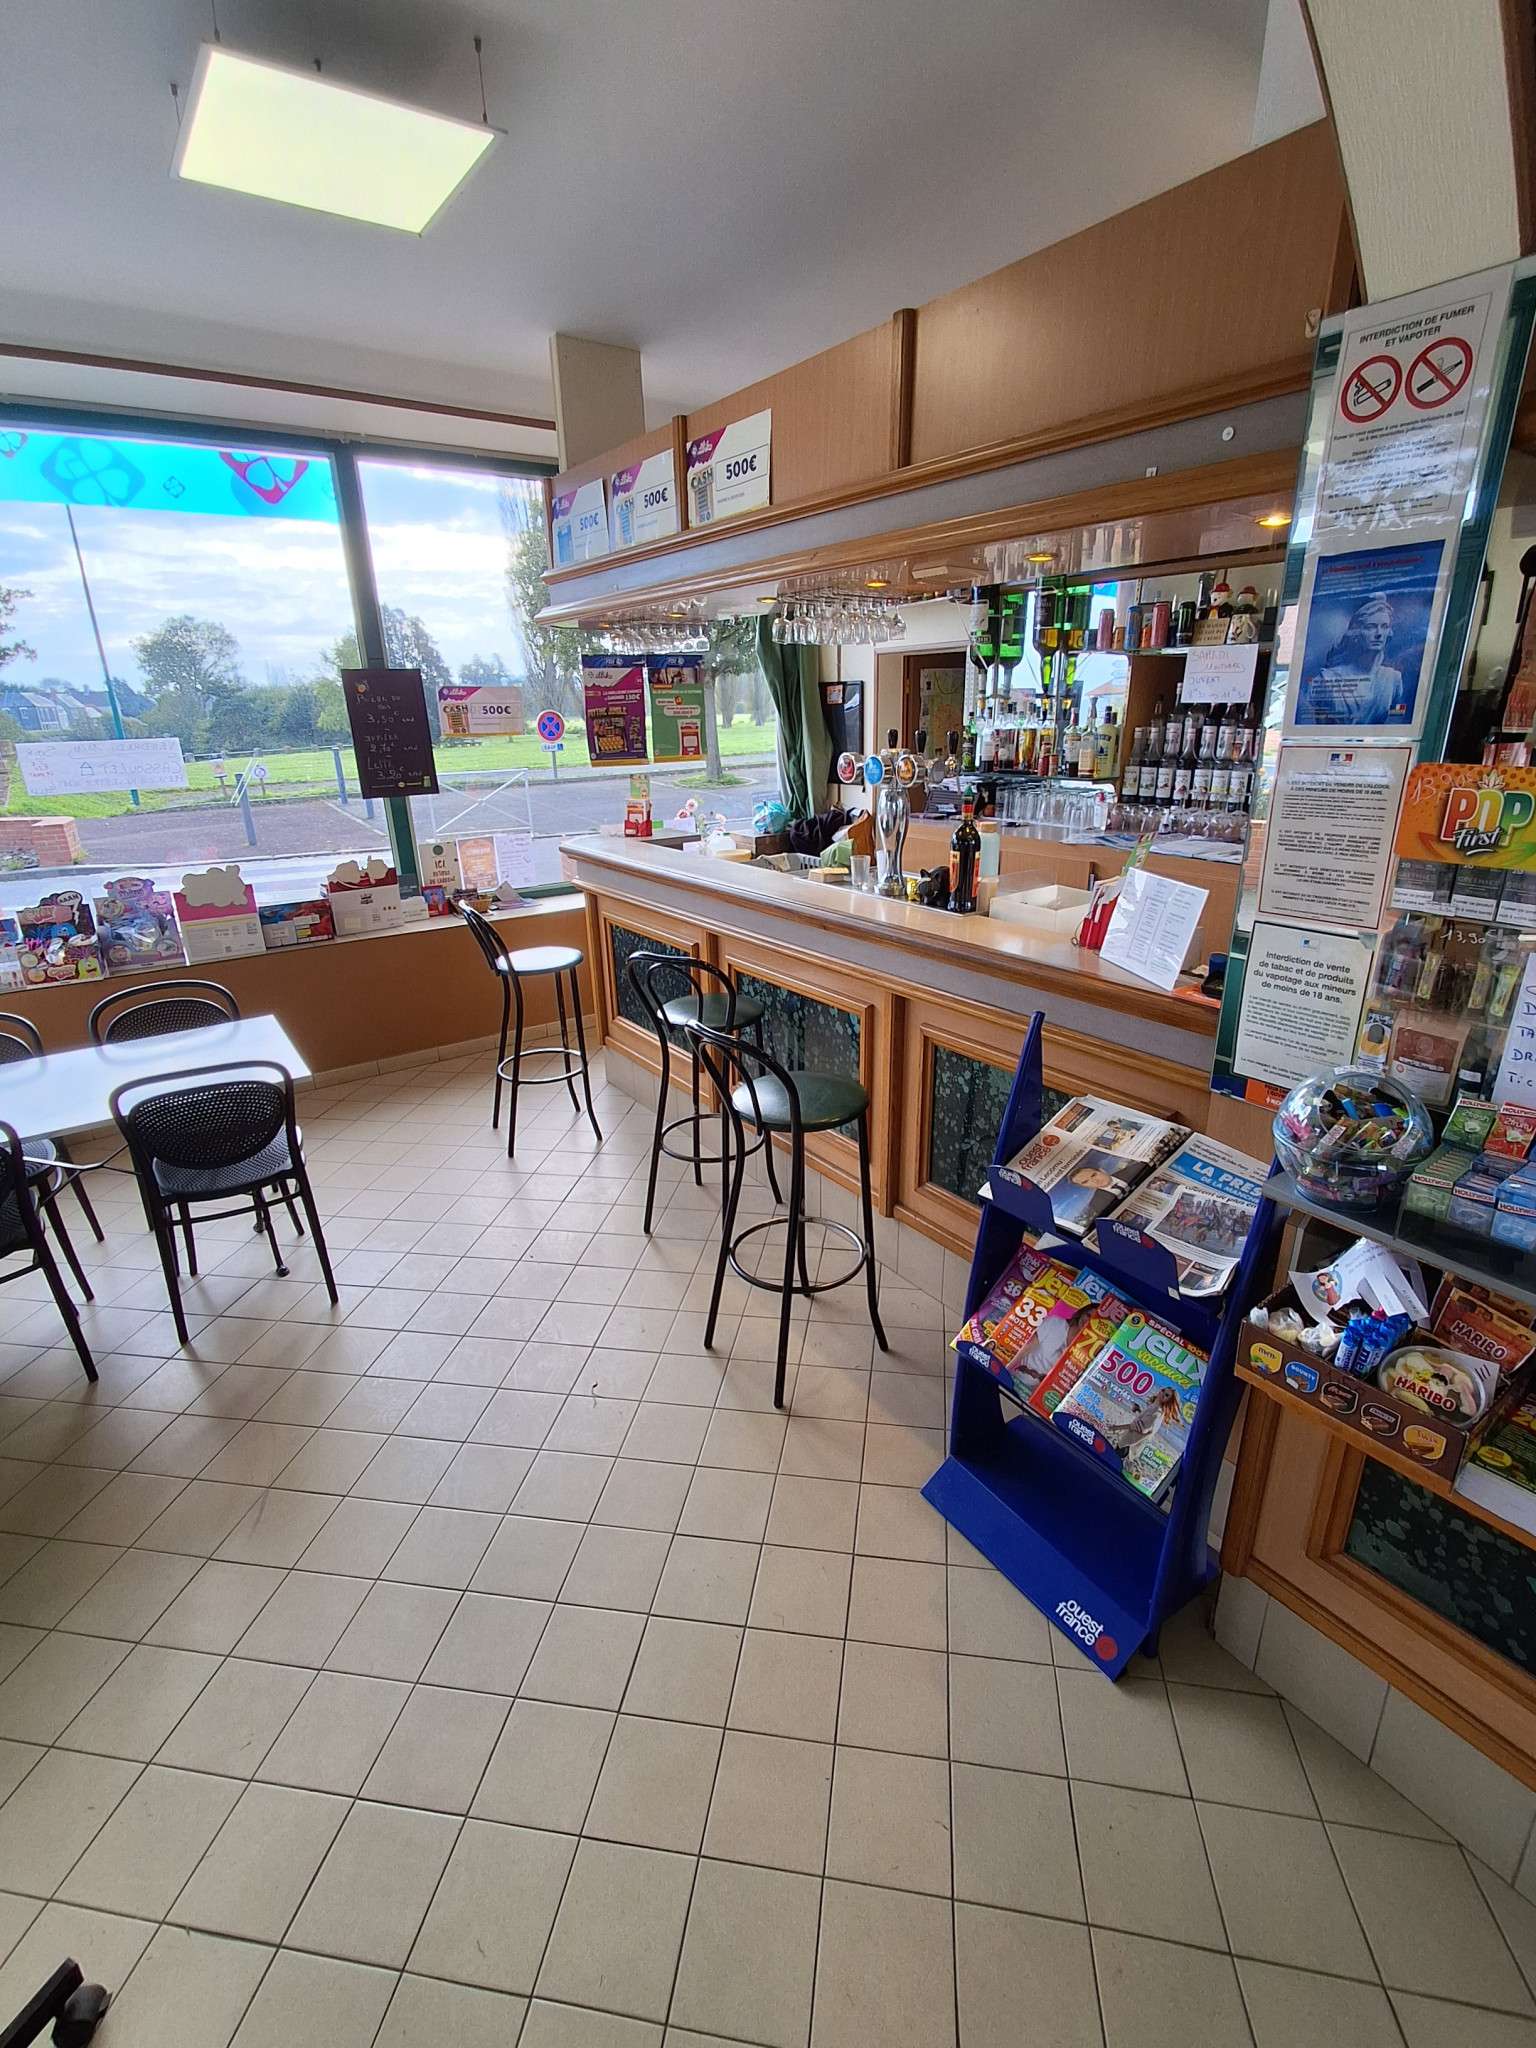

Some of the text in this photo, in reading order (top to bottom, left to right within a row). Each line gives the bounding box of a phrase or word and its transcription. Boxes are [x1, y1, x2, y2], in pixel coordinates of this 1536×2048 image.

[1360, 304, 1476, 344] INTERDICTION DE FUMER
[1384, 326, 1441, 348] ET VAPOTER
[690, 454, 758, 488] CASH 500€
[643, 488, 669, 510] 500€
[579, 512, 600, 531] 500€
[443, 704, 512, 715] CASH 500€
[1440, 787, 1535, 847] POP
[1453, 826, 1504, 849] First
[1259, 960, 1354, 986] de tabac et de produits
[1266, 951, 1351, 974] Interdiction de vente
[1254, 968, 1356, 996] du vapotage aux mineurs
[1261, 980, 1343, 1004] de moins de 18 ans.
[1018, 1143, 1042, 1166] ouest
[1020, 1147, 1052, 1170] france
[1192, 1162, 1262, 1197] LA PRES
[1201, 1176, 1214, 1185] DE
[1212, 1180, 1224, 1191] LA
[1414, 1175, 1452, 1188] HOLLYWOOD
[1454, 1188, 1495, 1202] HOLLYWOOD
[1004, 1280, 1022, 1297] 36
[1014, 1297, 1048, 1327] 33
[1148, 1318, 1186, 1347] SPÉCIAL
[1450, 1318, 1508, 1360] HARIBO
[1100, 1350, 1154, 1396] 500
[1136, 1350, 1193, 1390] vacances
[1394, 1376, 1457, 1412] HARIBO
[1068, 1420, 1094, 1446] france
[1072, 1418, 1096, 1440] ouest
[1142, 1447, 1154, 1458] 80
[1055, 1602, 1096, 1646] france
[1066, 1600, 1104, 1638] ouest
